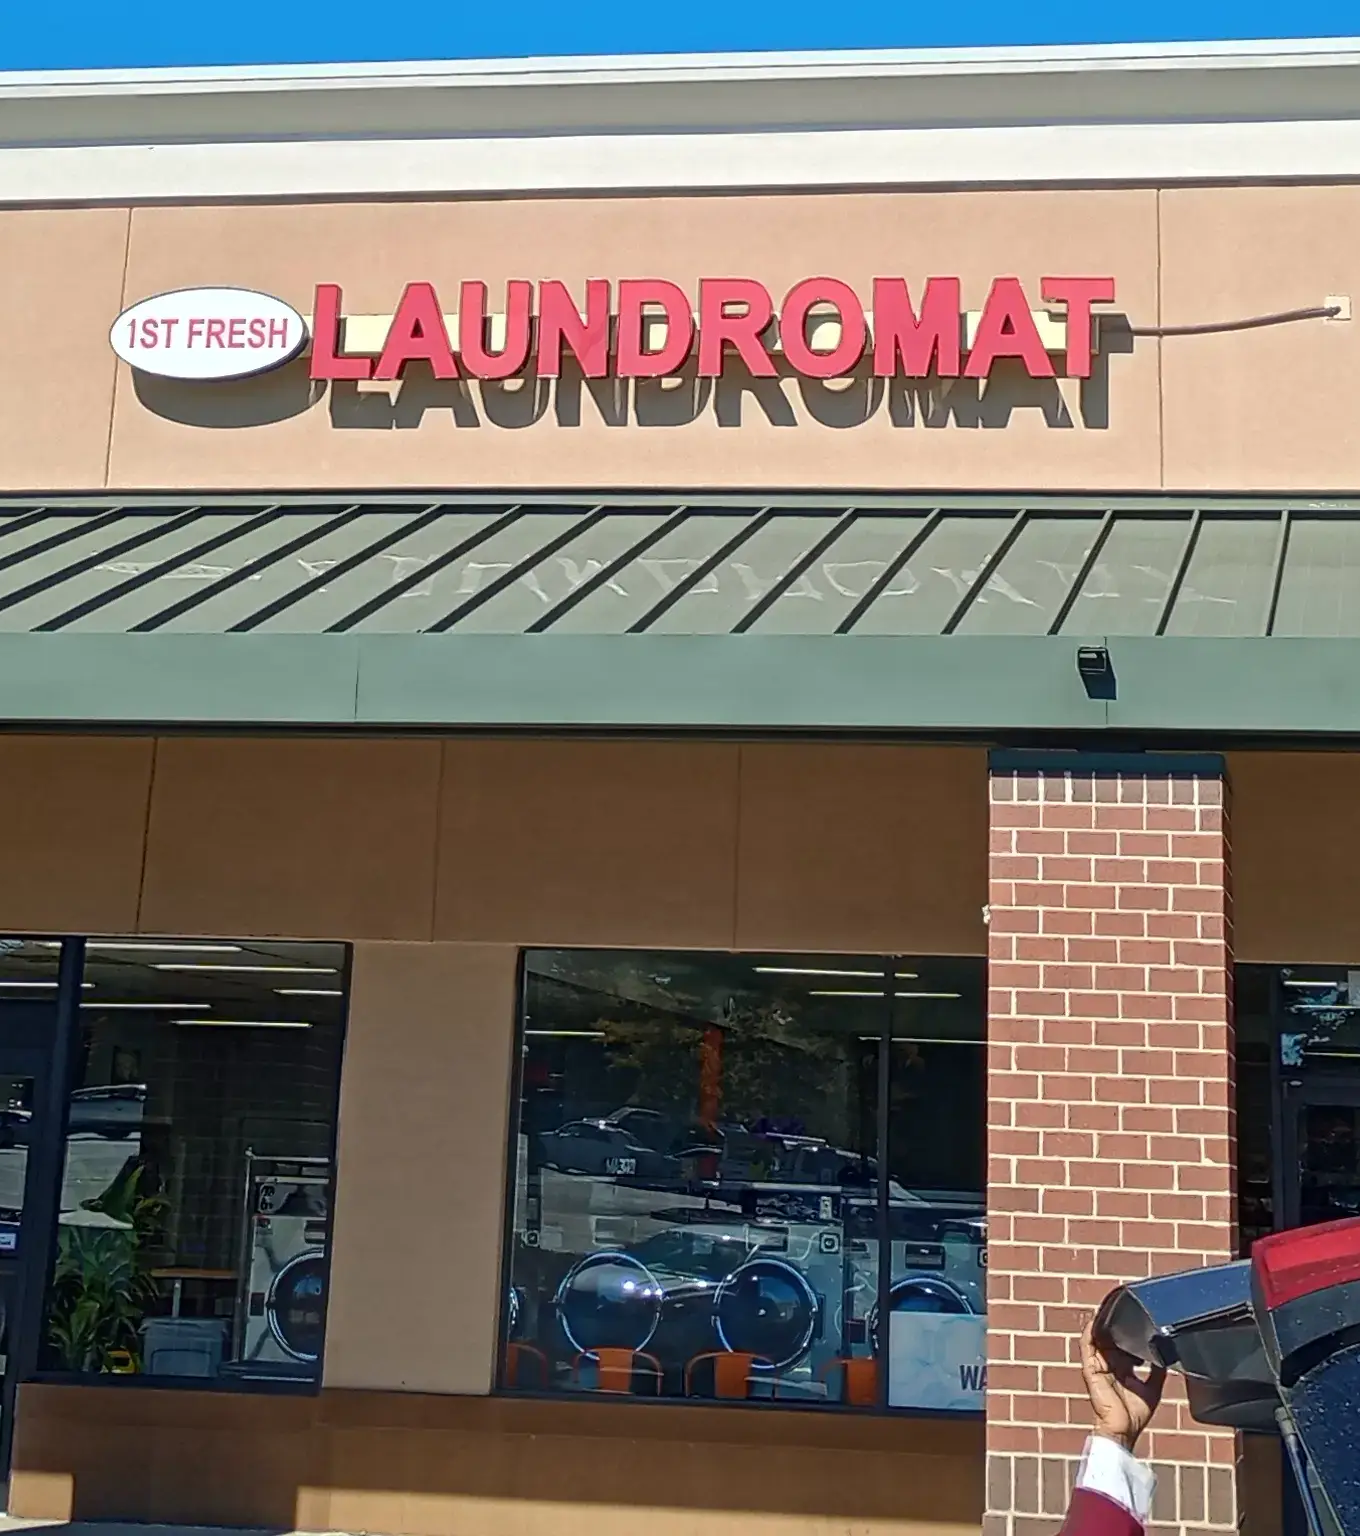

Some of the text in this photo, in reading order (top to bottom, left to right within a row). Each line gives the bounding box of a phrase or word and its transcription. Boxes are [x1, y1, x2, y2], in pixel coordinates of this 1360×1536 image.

[127, 318, 289, 349] 1ST FRESH
[309, 277, 1116, 381] LAUNDROMAT
